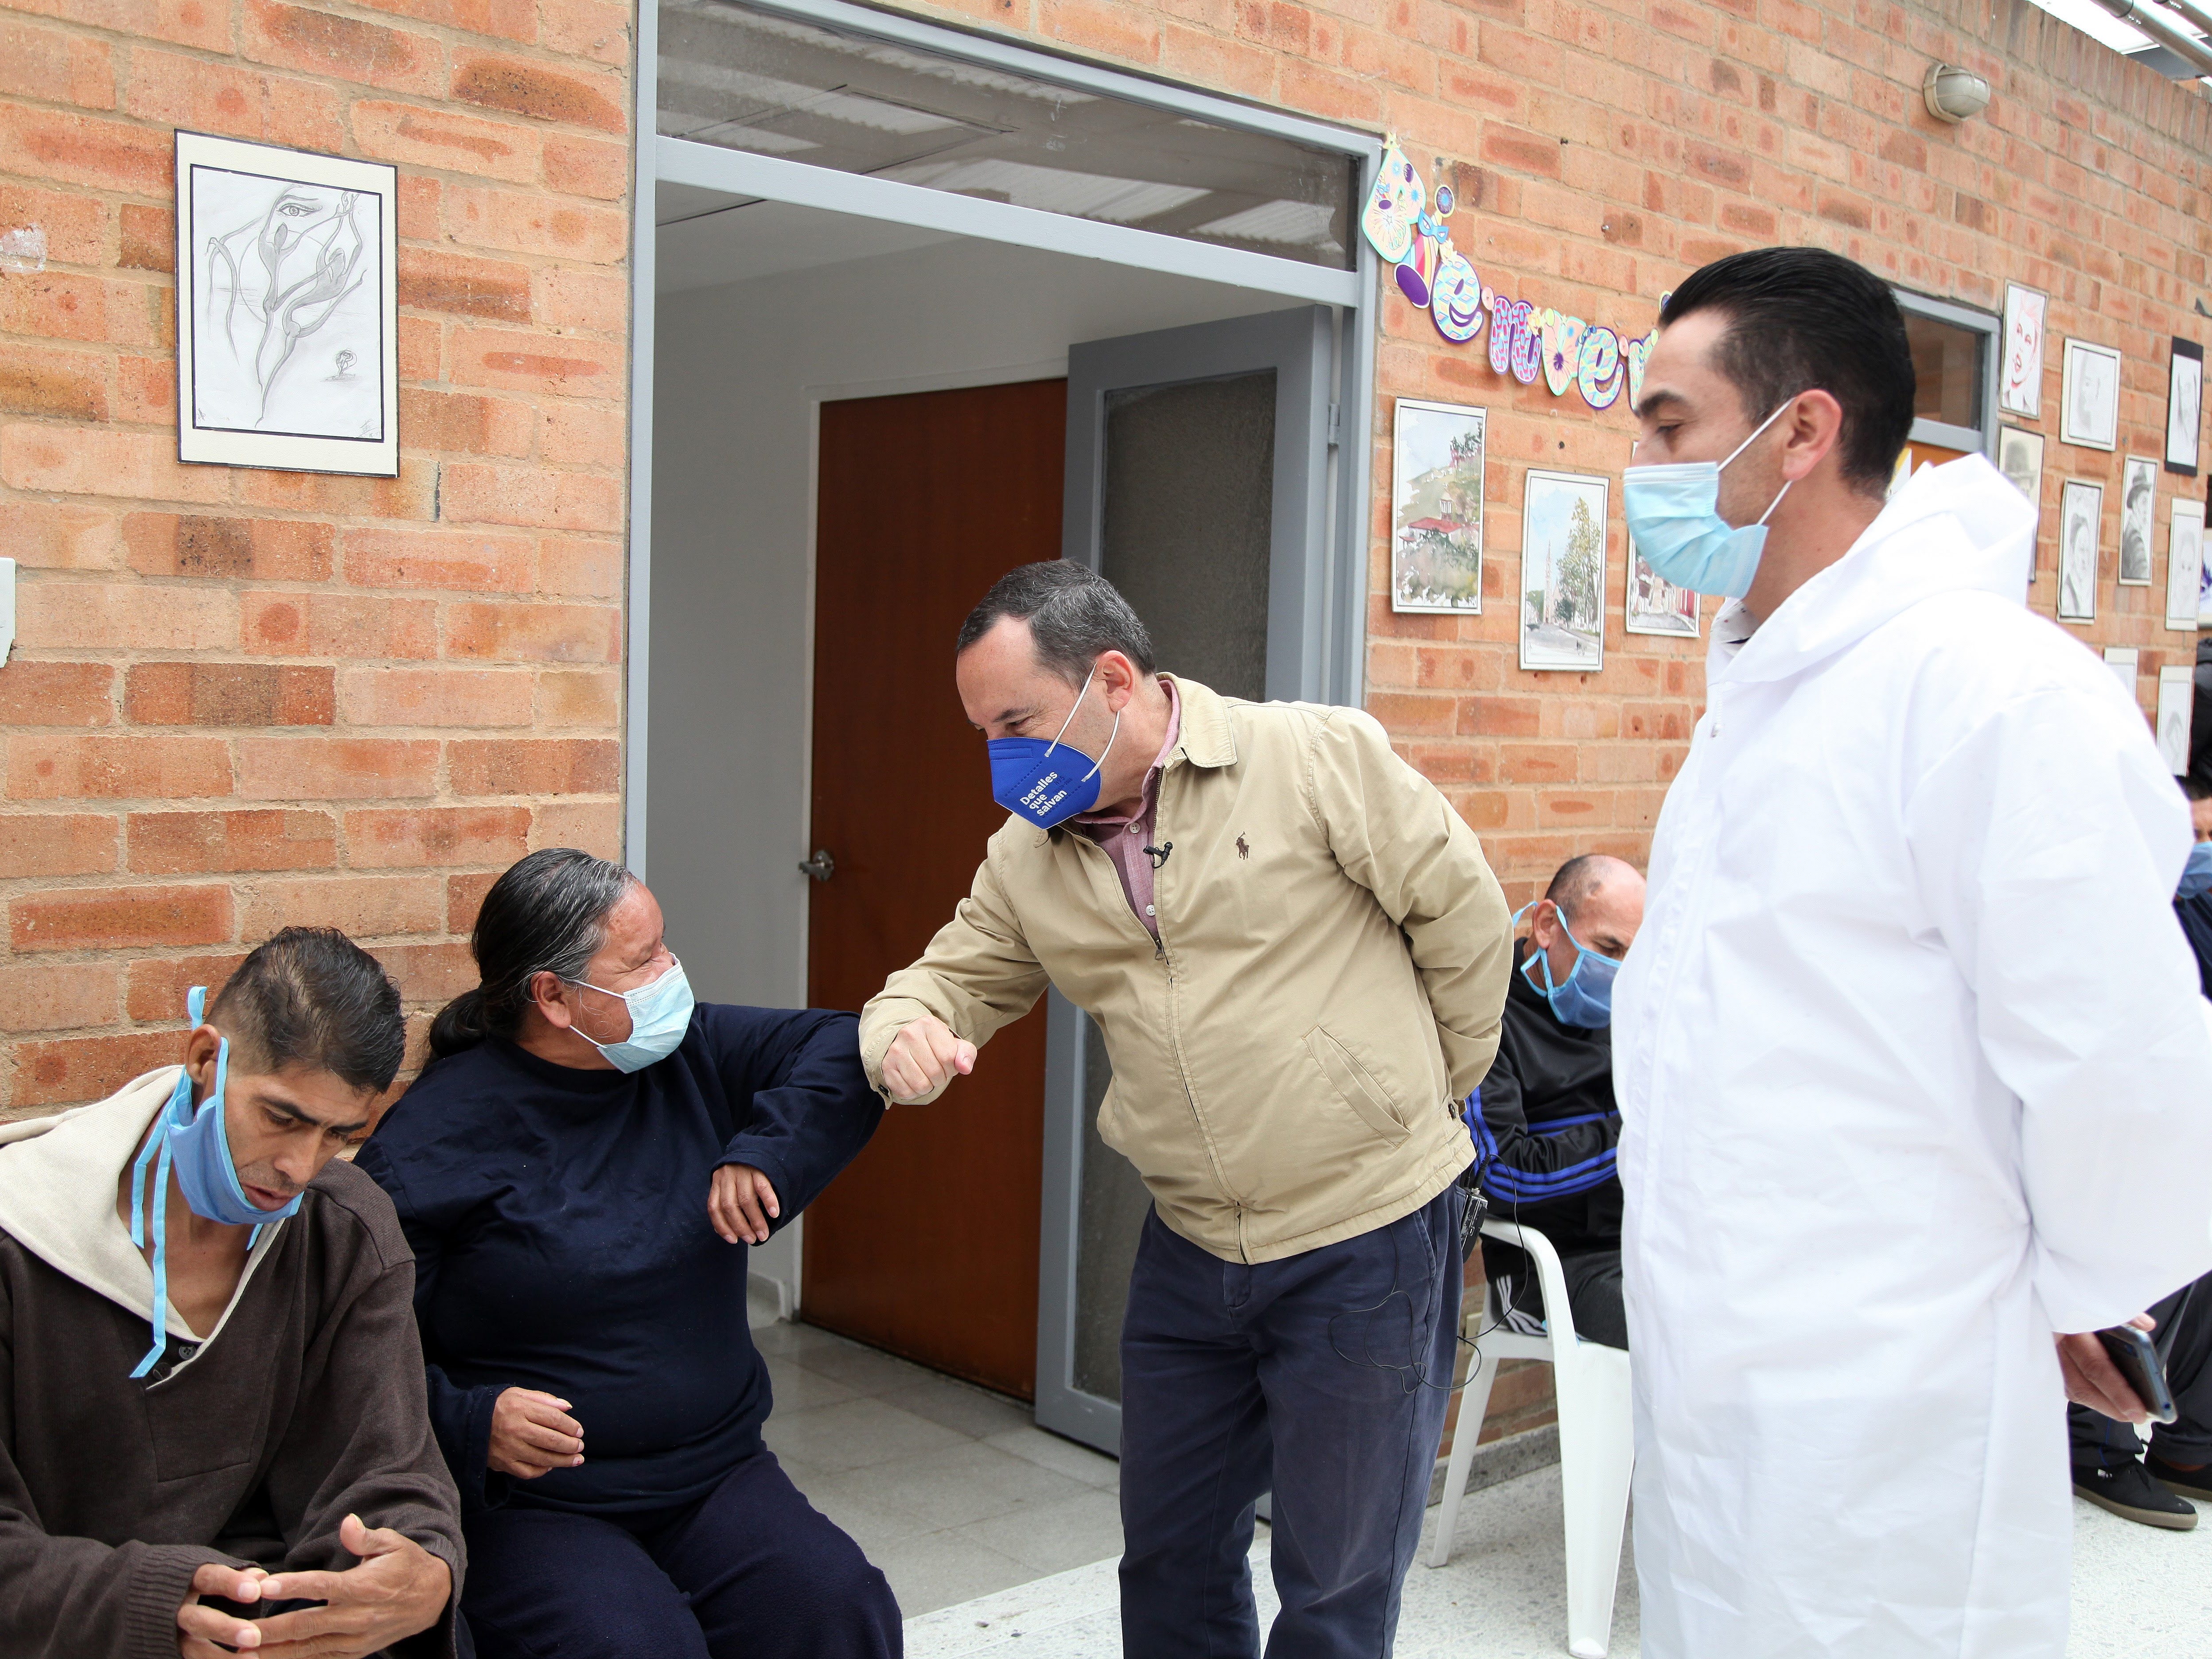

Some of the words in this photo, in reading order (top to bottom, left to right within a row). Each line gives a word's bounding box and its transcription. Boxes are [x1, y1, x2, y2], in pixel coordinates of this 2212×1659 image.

[1020, 771, 1058, 805] Detalles
[1054, 776, 1065, 786] N95
[1029, 794, 1048, 810] que
[1036, 790, 1067, 816] salvan
